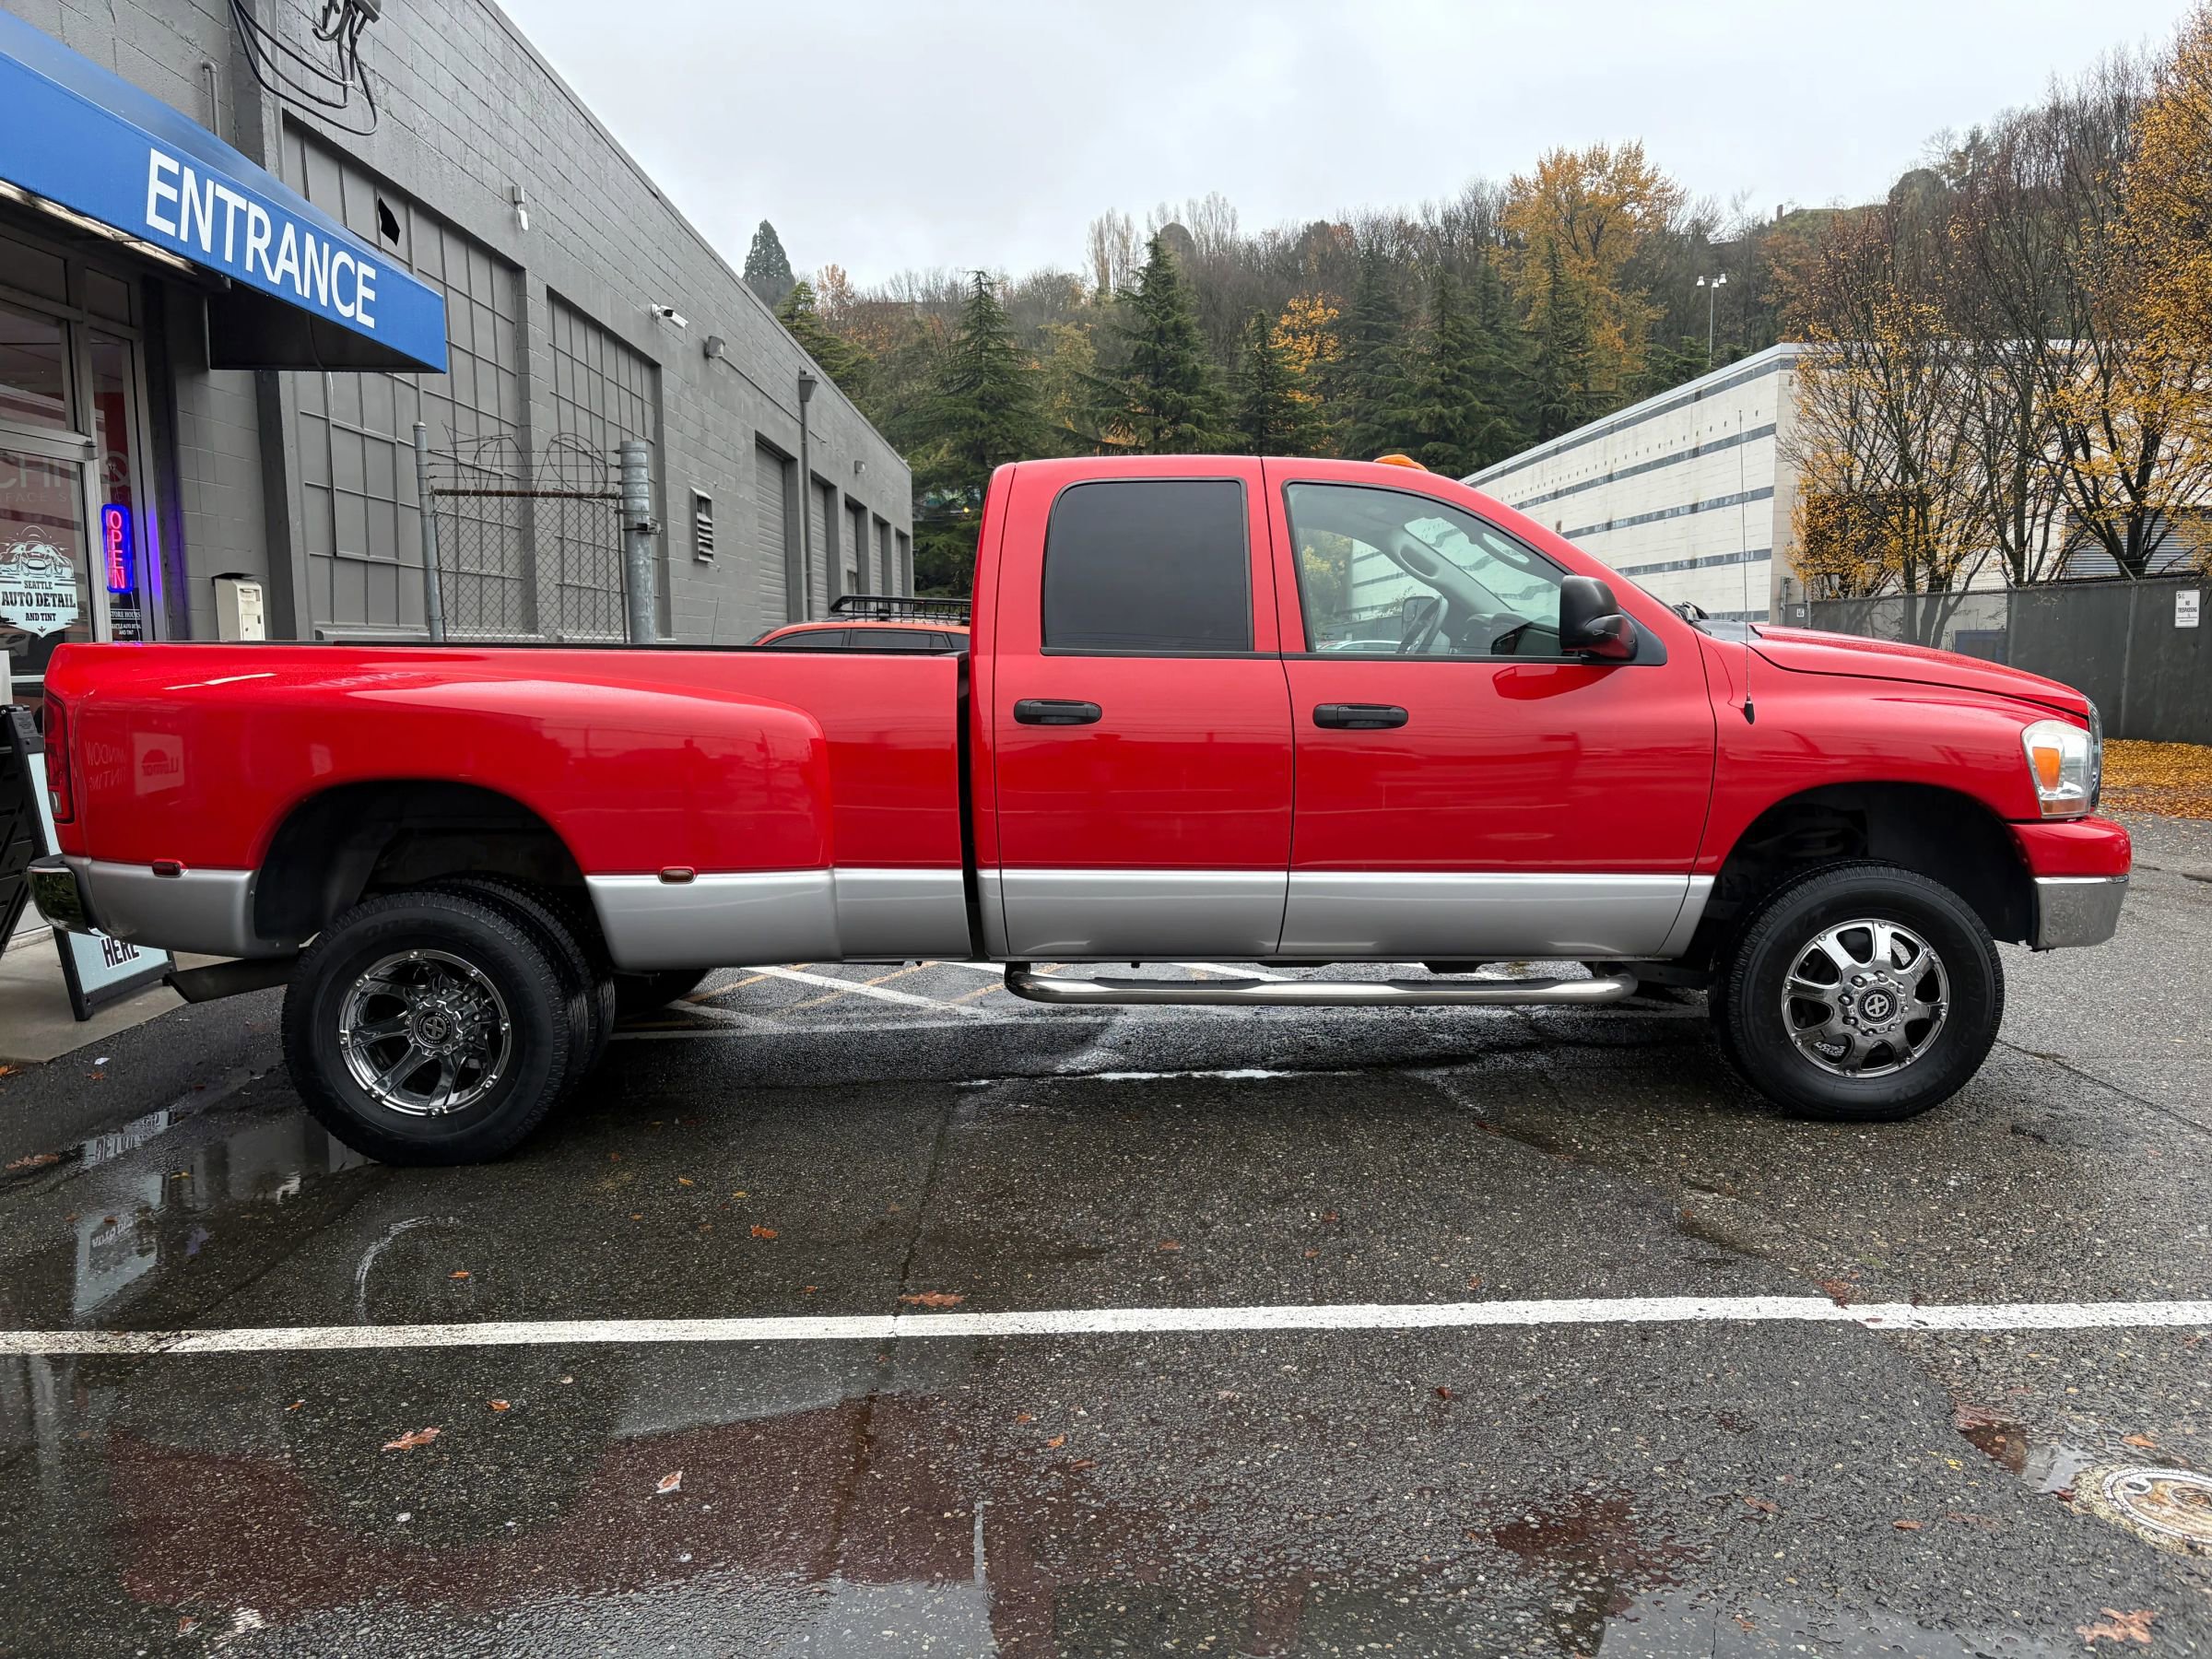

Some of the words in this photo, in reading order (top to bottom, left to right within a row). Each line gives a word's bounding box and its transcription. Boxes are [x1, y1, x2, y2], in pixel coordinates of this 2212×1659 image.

[146, 147, 377, 328] ENTRANCE
[5, 492, 47, 502] FACE
[109, 510, 126, 590] OPEN
[24, 580, 53, 590] SEATTLE
[2, 591, 33, 606] AUTO
[35, 593, 76, 608] DETAIL
[26, 612, 40, 621] AND
[40, 613, 56, 621] TINT
